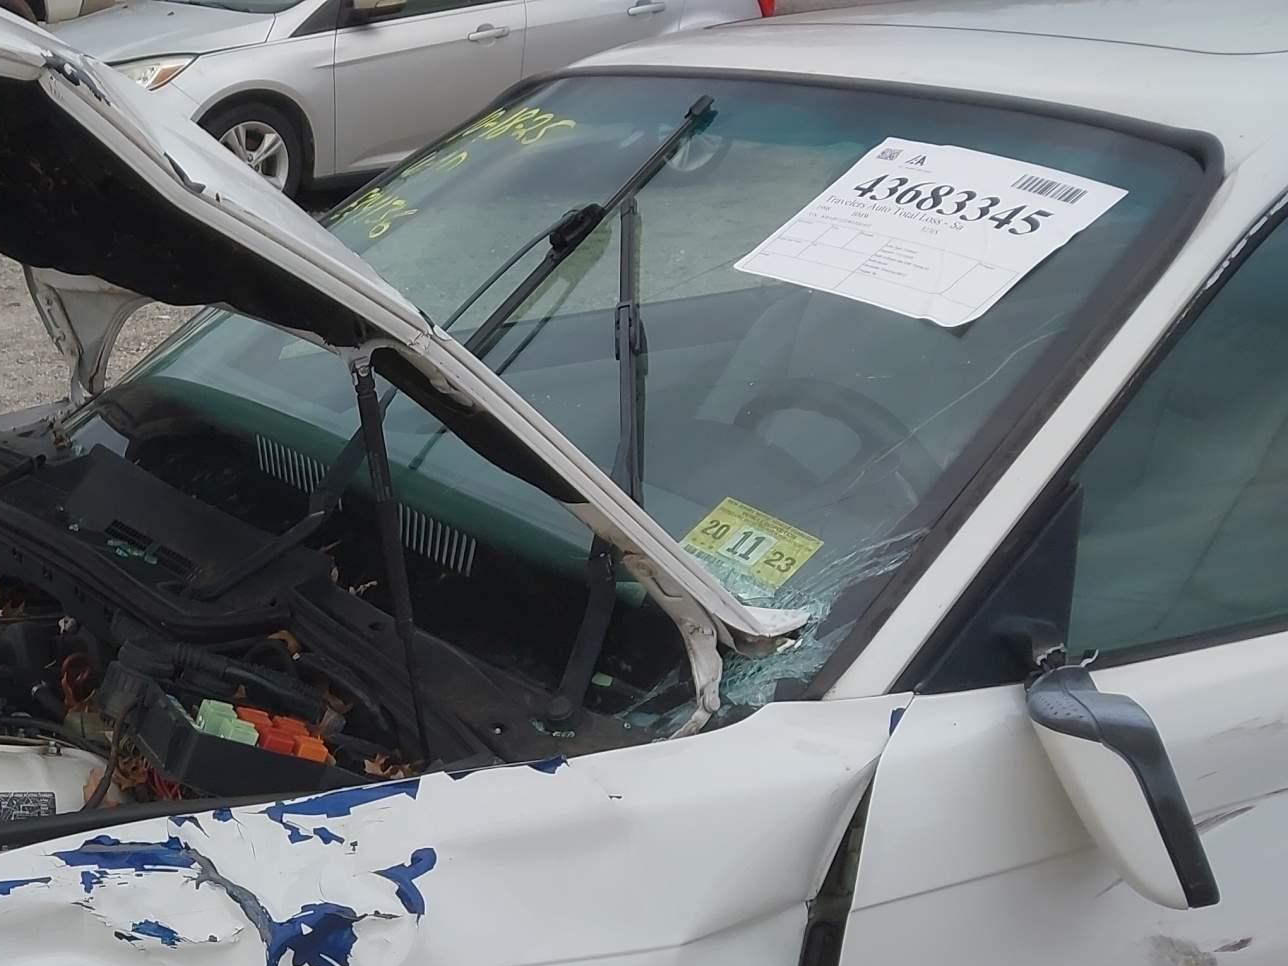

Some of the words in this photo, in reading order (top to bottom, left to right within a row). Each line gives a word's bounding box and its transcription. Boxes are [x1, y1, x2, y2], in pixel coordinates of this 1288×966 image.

[826, 194, 866, 209] Travelers
[869, 203, 891, 214] Auto
[891, 207, 918, 221] Total
[918, 213, 943, 226] Loss
[853, 174, 1053, 236] 43683345
[701, 519, 730, 540] 20
[726, 530, 766, 560] 11
[763, 550, 797, 573] 23
